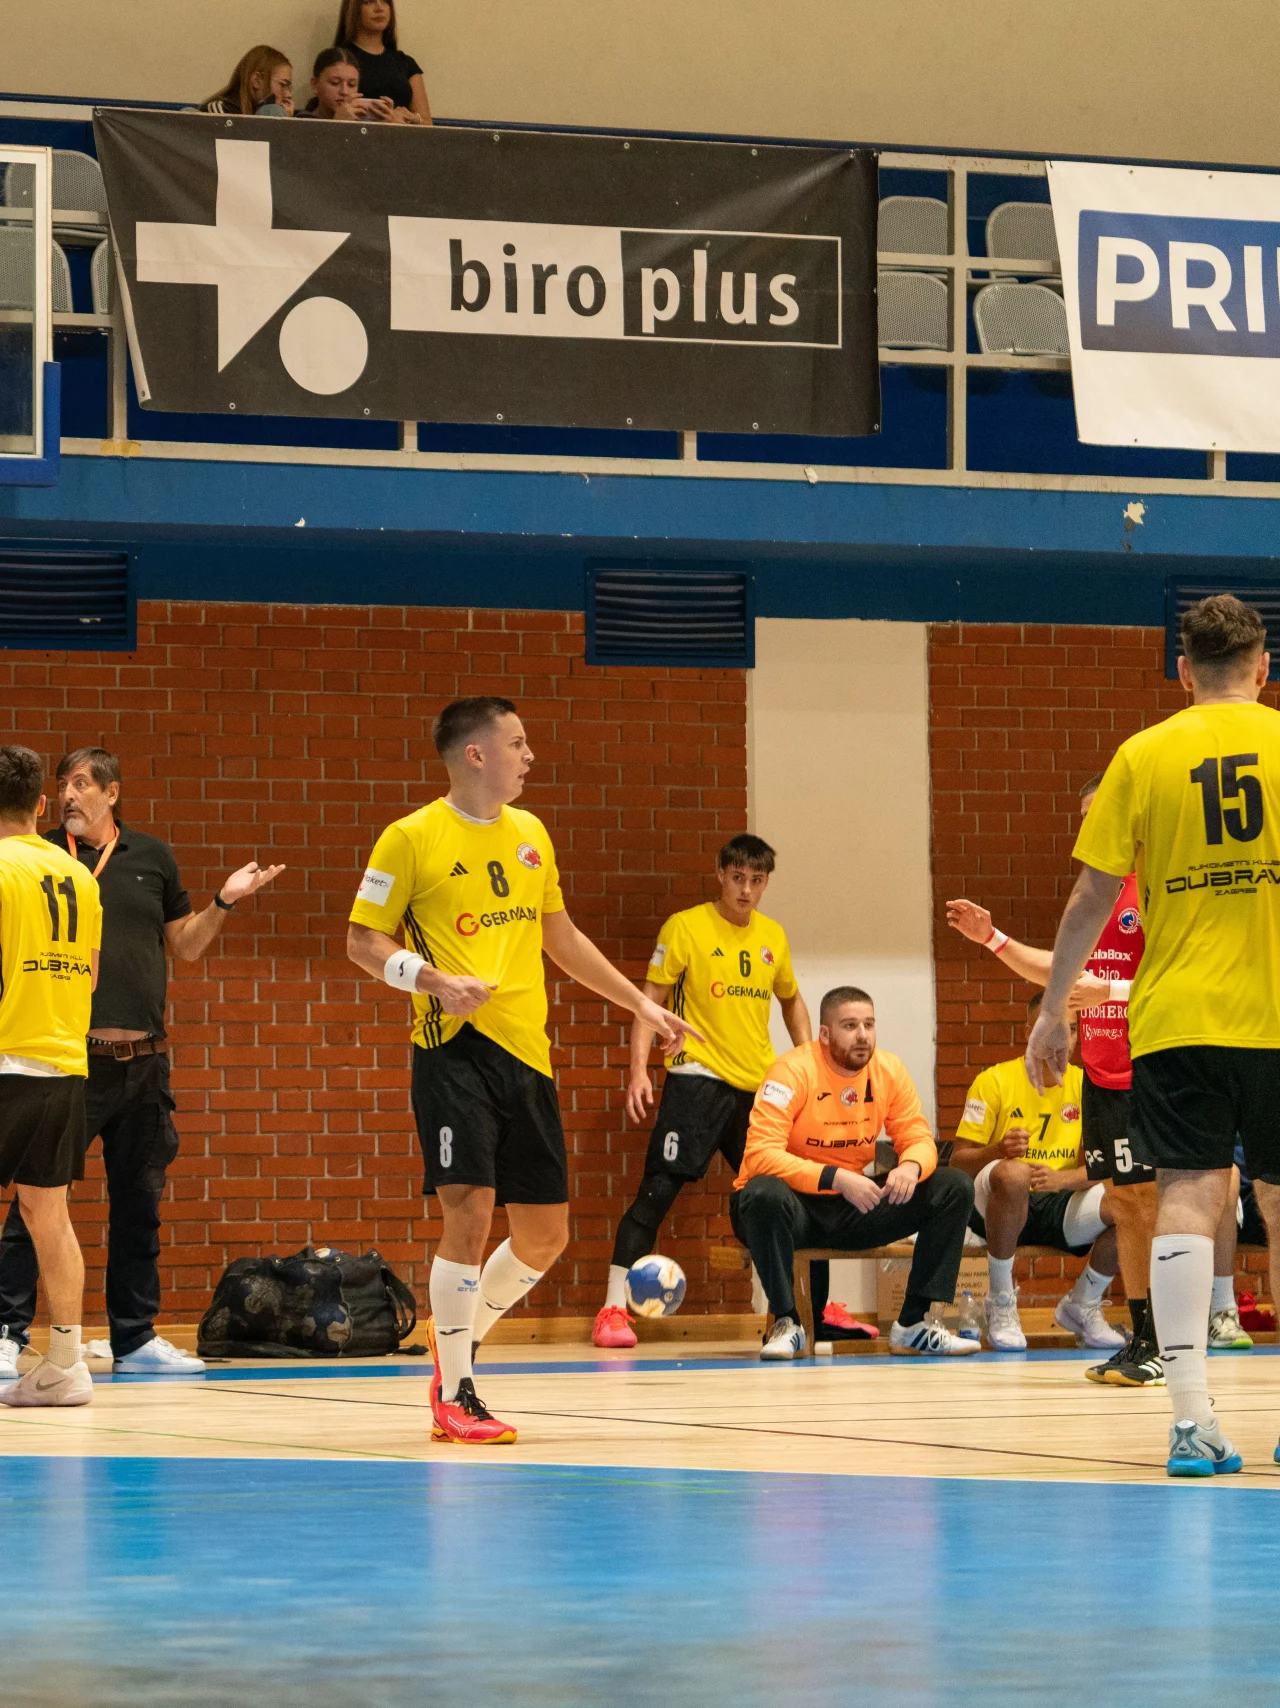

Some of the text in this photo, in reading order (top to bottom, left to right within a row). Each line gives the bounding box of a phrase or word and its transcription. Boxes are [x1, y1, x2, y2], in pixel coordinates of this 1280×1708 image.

[449, 239, 800, 334] biro plus
[1096, 235, 1280, 334] PRI
[1190, 753, 1263, 845] 15
[487, 861, 510, 897] 8
[39, 875, 78, 943] 11
[739, 950, 751, 977] 6
[663, 1131, 679, 1161] 6
[1038, 1113, 1051, 1141] 7
[439, 1126, 452, 1168] 8
[1025, 1148, 1075, 1160] ERMANIA
